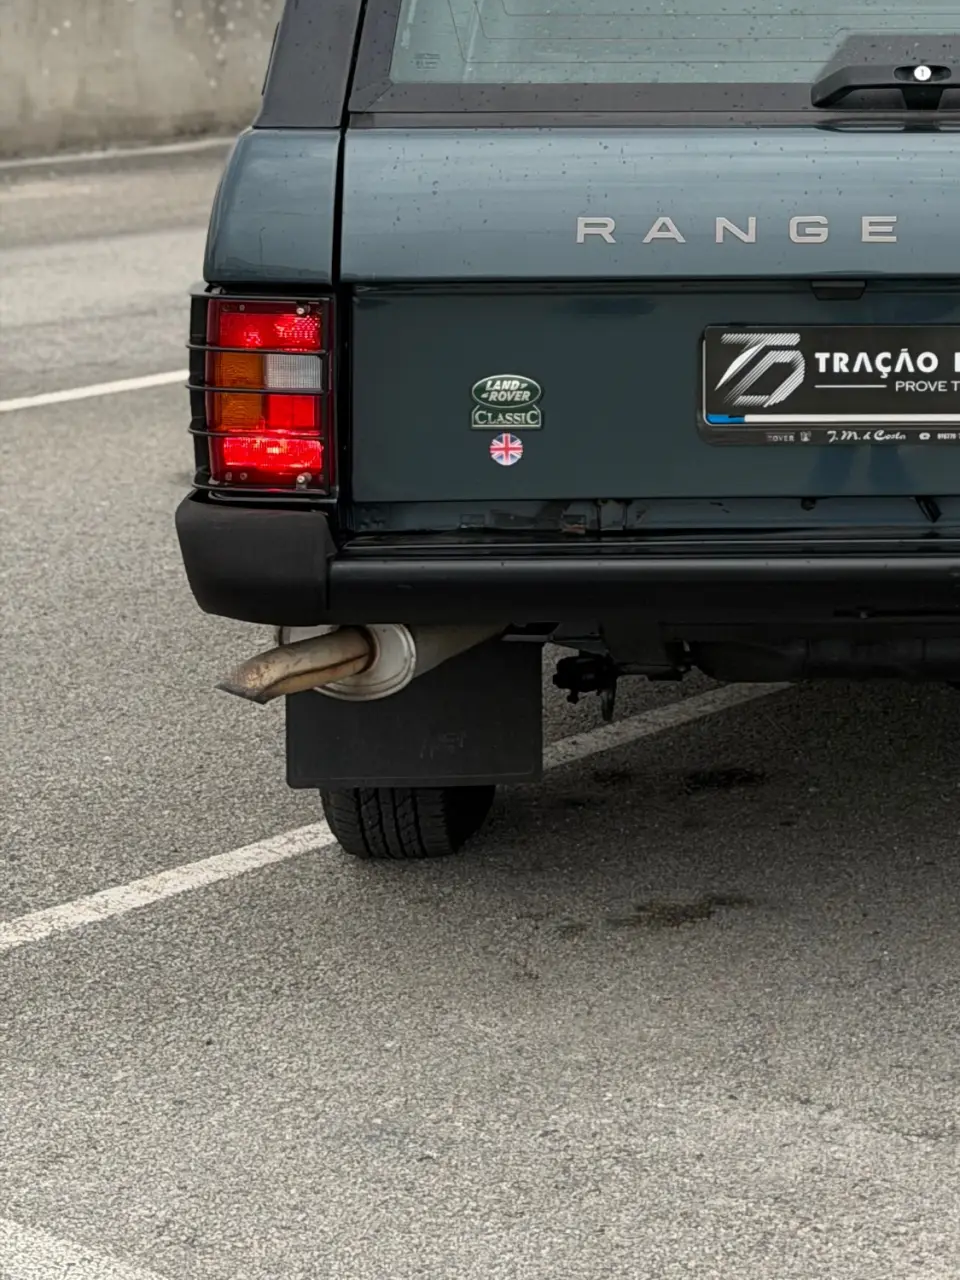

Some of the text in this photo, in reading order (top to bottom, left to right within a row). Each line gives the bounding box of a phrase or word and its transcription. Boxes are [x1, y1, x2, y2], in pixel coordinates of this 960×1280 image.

[576, 215, 897, 244] RANGE
[814, 348, 939, 378] TRAÇÃO
[485, 380, 520, 391] LAND
[895, 380, 948, 392] PROVE
[488, 390, 531, 402] ROVER
[475, 410, 538, 425] CLASSIC
